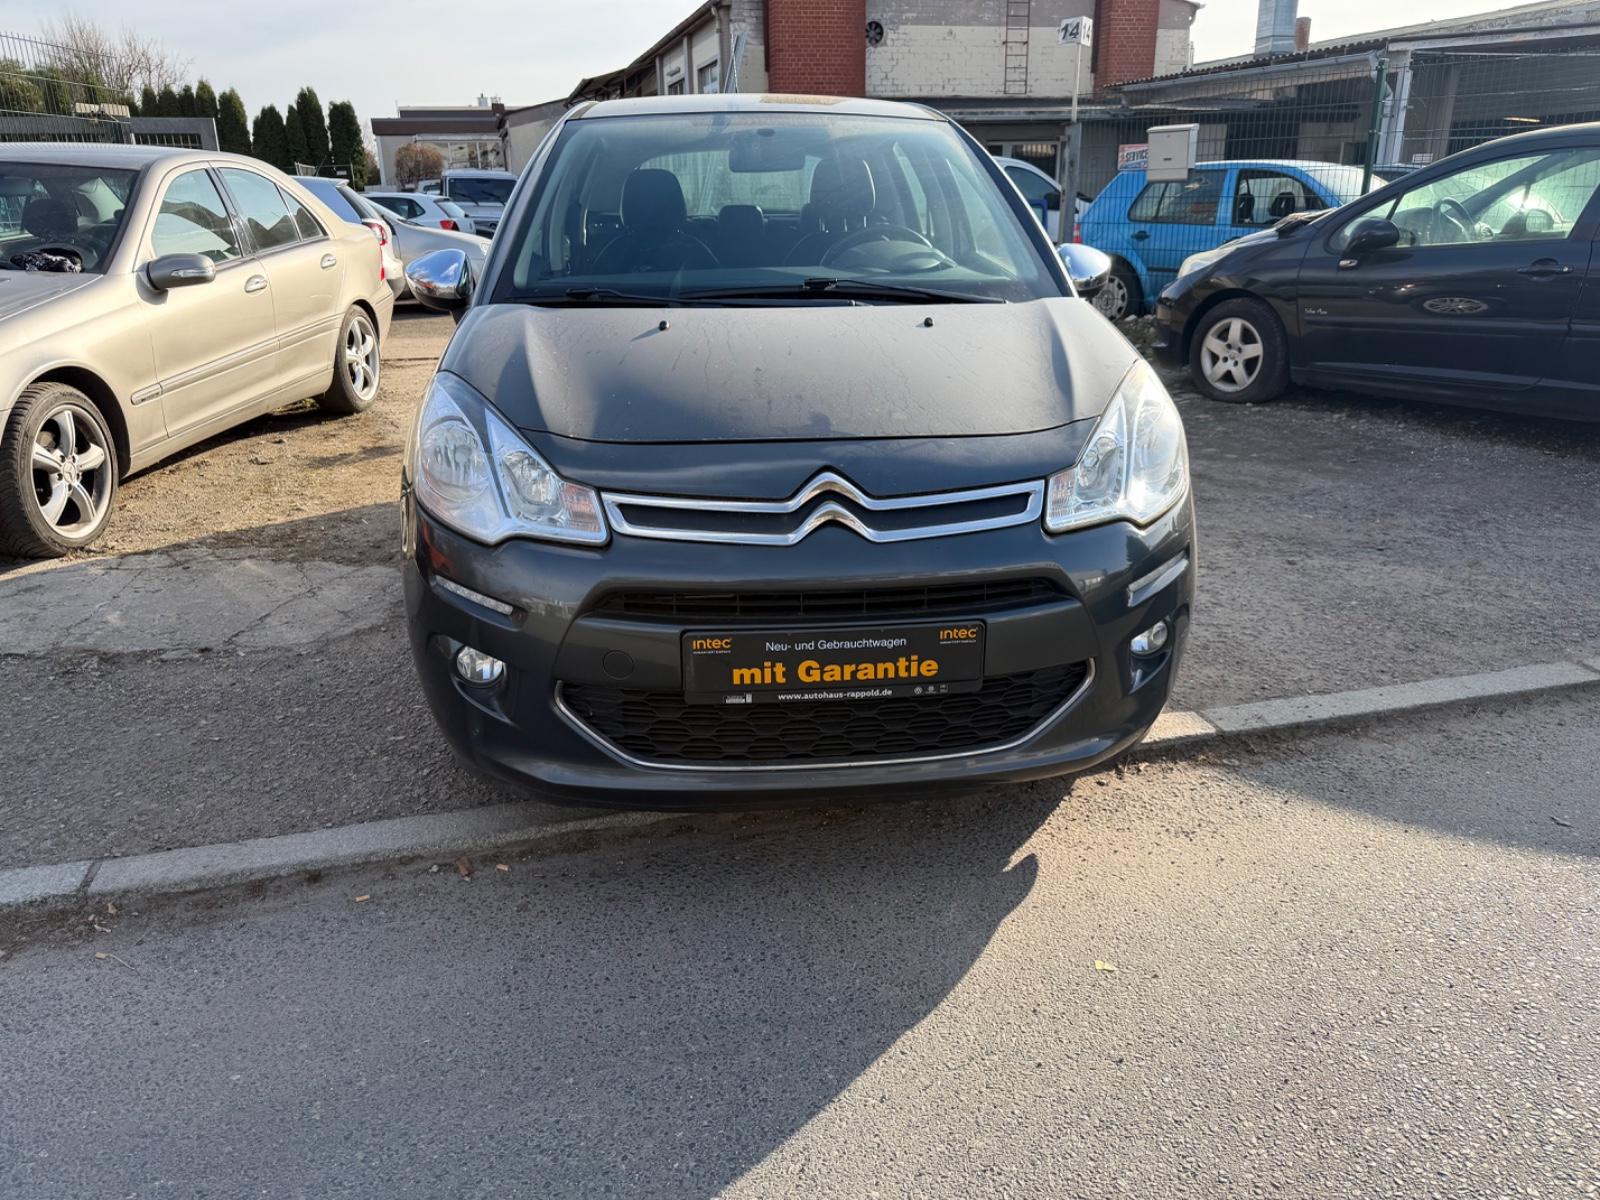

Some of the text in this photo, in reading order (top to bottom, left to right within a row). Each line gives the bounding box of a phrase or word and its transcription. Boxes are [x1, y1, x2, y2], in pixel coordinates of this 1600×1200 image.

[1061, 22, 1080, 40] 14
[940, 626, 977, 640] intec
[692, 638, 732, 650] intec
[765, 638, 907, 652] Neu- und Gebrauchtwagen
[733, 655, 939, 685] mit Garantie
[778, 688, 893, 700] www.autohaus-rappold.de
